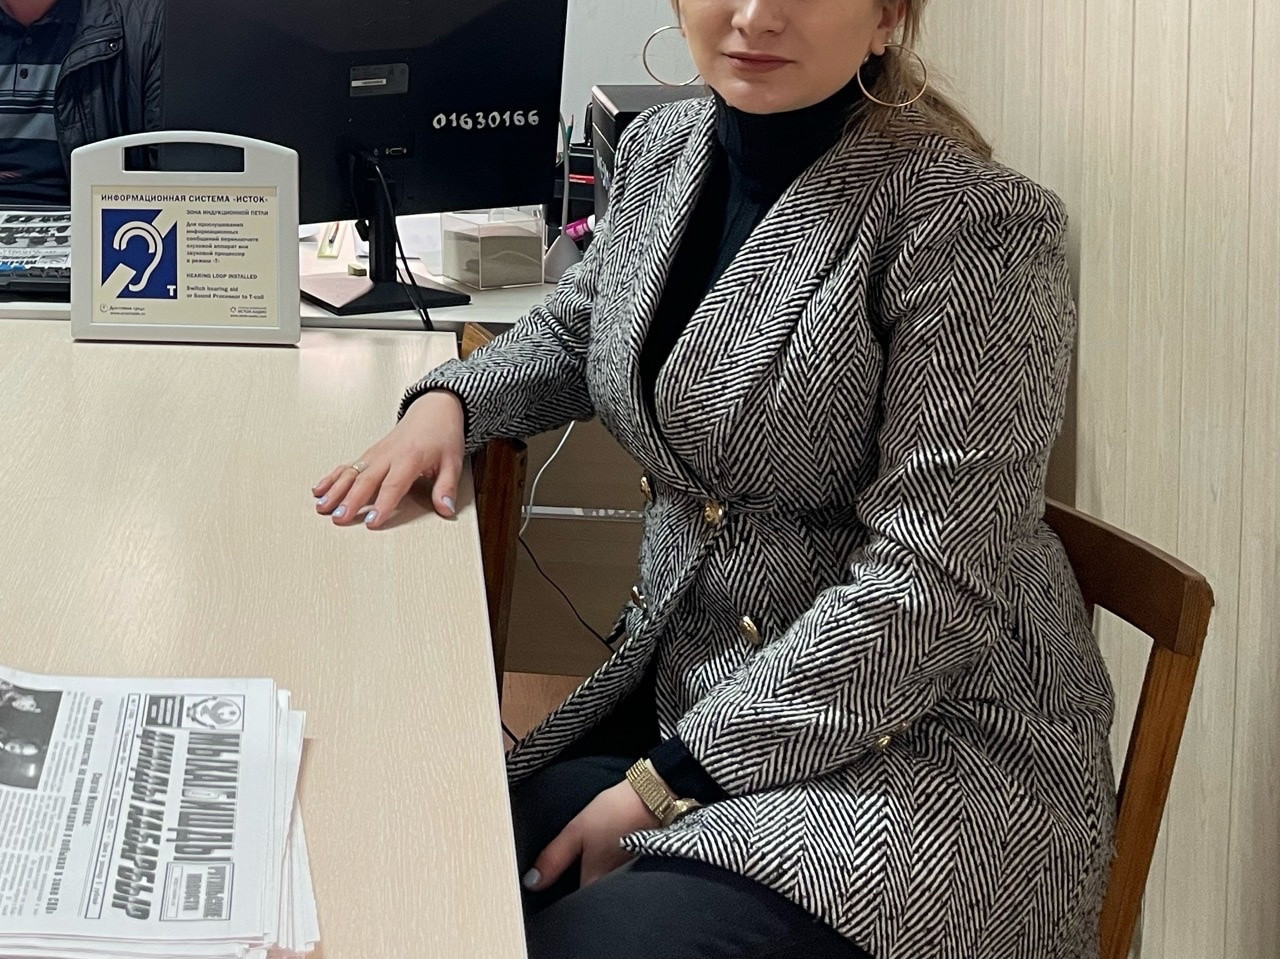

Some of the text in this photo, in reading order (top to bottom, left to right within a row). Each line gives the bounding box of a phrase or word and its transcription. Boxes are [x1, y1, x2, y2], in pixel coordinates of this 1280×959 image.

[432, 109, 540, 130] 01630166
[101, 194, 186, 203] ИНФОРМАЦИОННАЯ
[188, 195, 230, 203] СИСТЕМА
[167, 285, 176, 296] T
[56, 838, 72, 870] побывал
[111, 803, 165, 920] ХАБАРБЫР
[49, 878, 62, 896] зоне
[183, 873, 203, 912] НОВОСТИ
